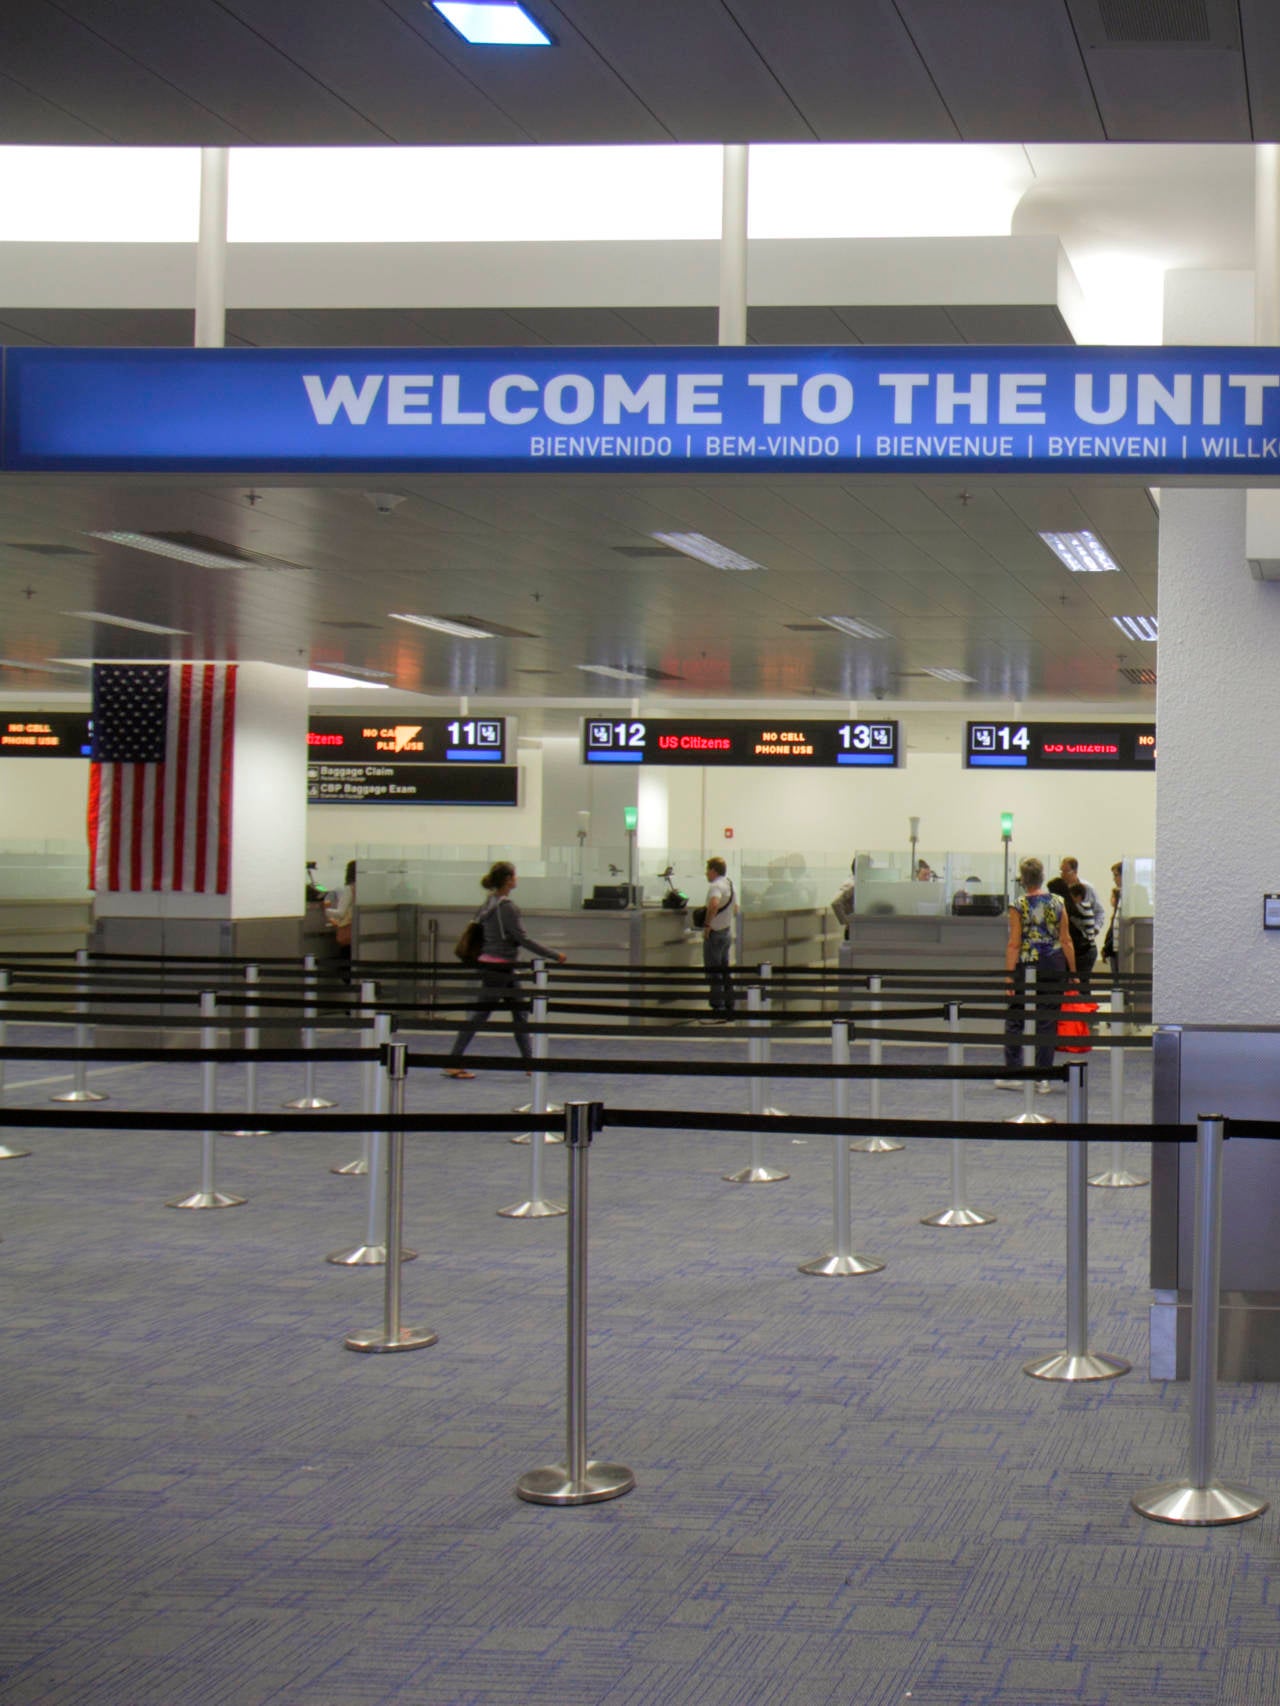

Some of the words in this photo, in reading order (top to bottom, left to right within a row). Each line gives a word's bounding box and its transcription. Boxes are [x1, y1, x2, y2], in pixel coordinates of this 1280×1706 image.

[302, 373, 723, 426] WELCOME
[748, 373, 854, 425] TO
[879, 373, 1046, 425] THE
[530, 435, 673, 457] BIENVENIDO
[706, 435, 840, 457] BEM-VINDO
[876, 435, 1014, 457] BIENVENUE
[1048, 435, 1167, 457] BYENVENI
[8, 724, 24, 733] NO
[363, 729, 378, 738] NO
[447, 722, 476, 745] 11
[615, 723, 646, 747] 12
[762, 732, 778, 742] NO
[780, 732, 806, 742] CELL
[838, 725, 868, 748] 13
[998, 727, 1030, 750] 14
[1138, 735, 1155, 746] NO
[1, 737, 37, 746] PHONE
[38, 737, 60, 746] USE
[658, 735, 678, 749] US
[680, 736, 731, 750] Citizens
[755, 745, 790, 755] PHONE
[792, 745, 814, 755] USE
[320, 767, 364, 778] Baggage
[365, 767, 394, 776] Claim
[344, 784, 387, 795] Baggage
[389, 785, 416, 794] Exam
